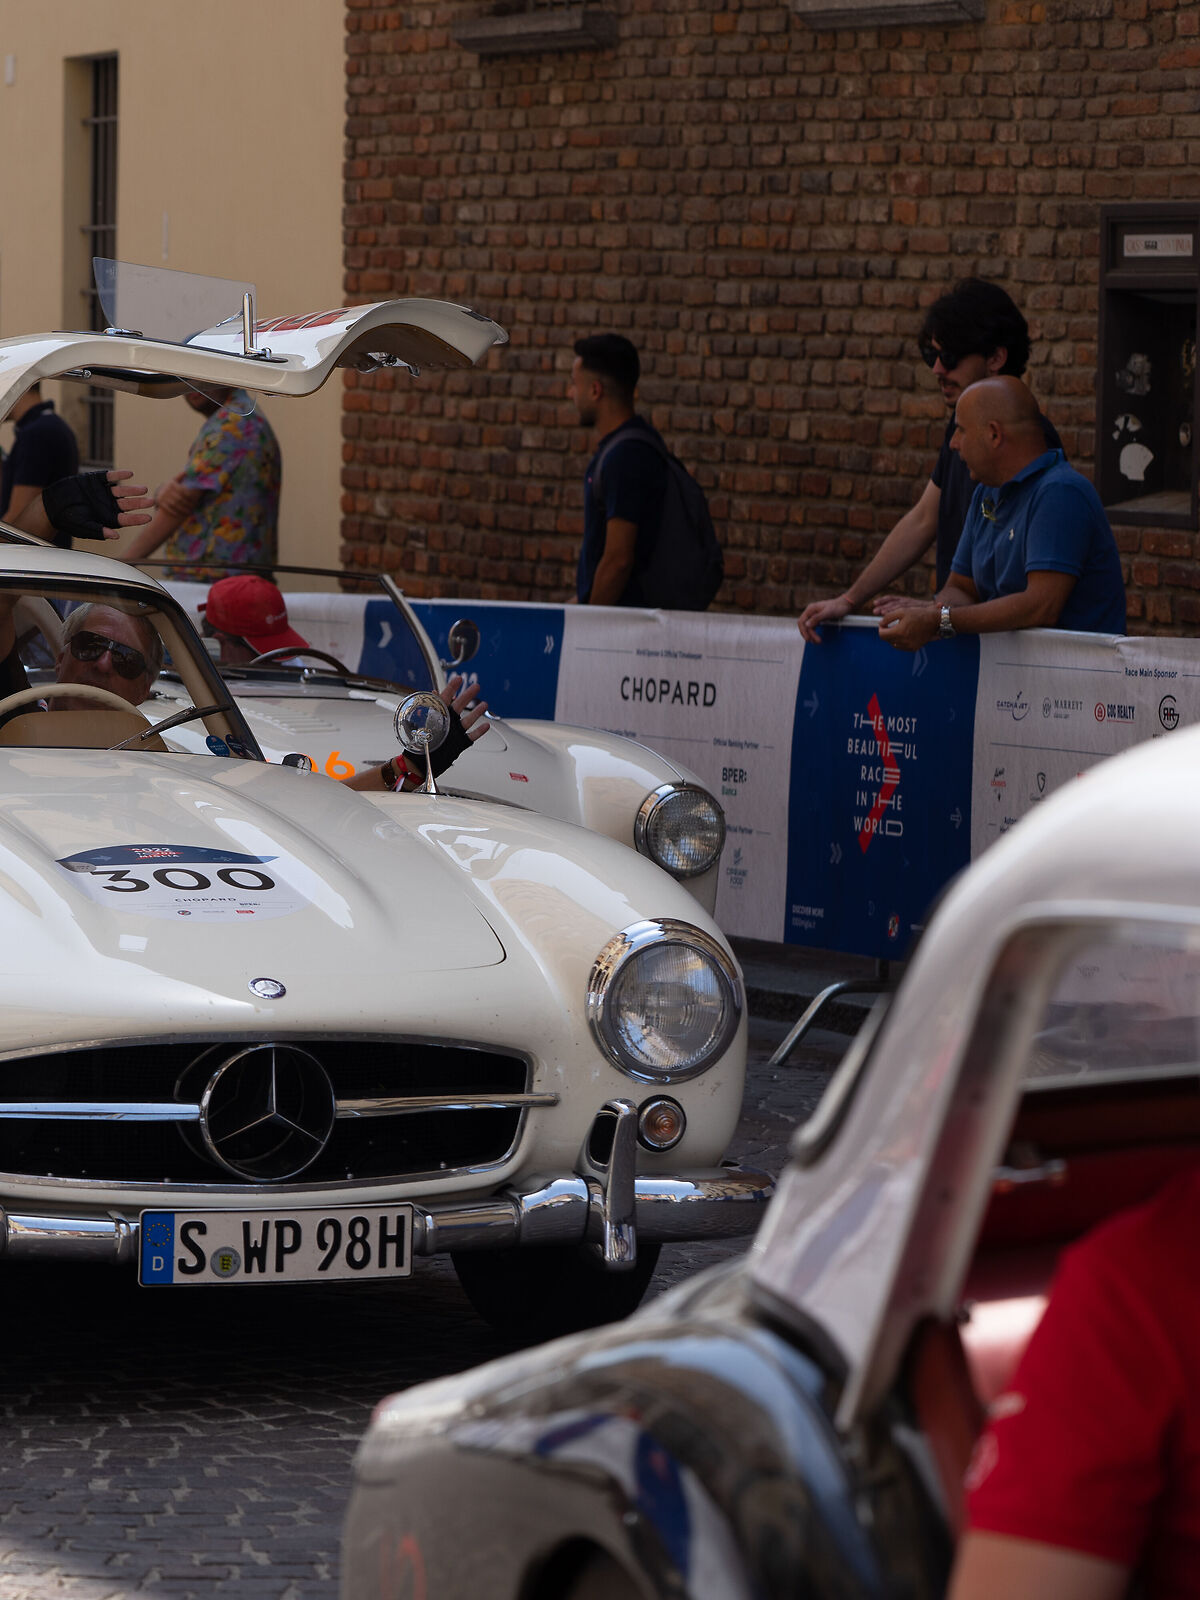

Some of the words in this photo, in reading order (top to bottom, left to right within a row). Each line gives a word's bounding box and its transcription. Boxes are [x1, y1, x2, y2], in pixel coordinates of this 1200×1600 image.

[1125, 667, 1138, 677] Race
[1140, 668, 1152, 677] Main
[1154, 669, 1178, 679] Sponsor
[620, 676, 717, 707] CHOPARD
[1117, 704, 1135, 720] REALTY
[853, 713, 883, 731] THE
[887, 715, 917, 734] MOST
[847, 738, 917, 760] BEAUTIFUL
[860, 765, 900, 784] RACE
[856, 790, 868, 806] IN
[872, 792, 902, 811] THE
[853, 816, 903, 836] WORLD
[90, 867, 276, 893] 300
[178, 1220, 207, 1275] S
[242, 1219, 301, 1274] WP
[316, 1214, 405, 1272] 98H
[152, 1256, 164, 1272] D
